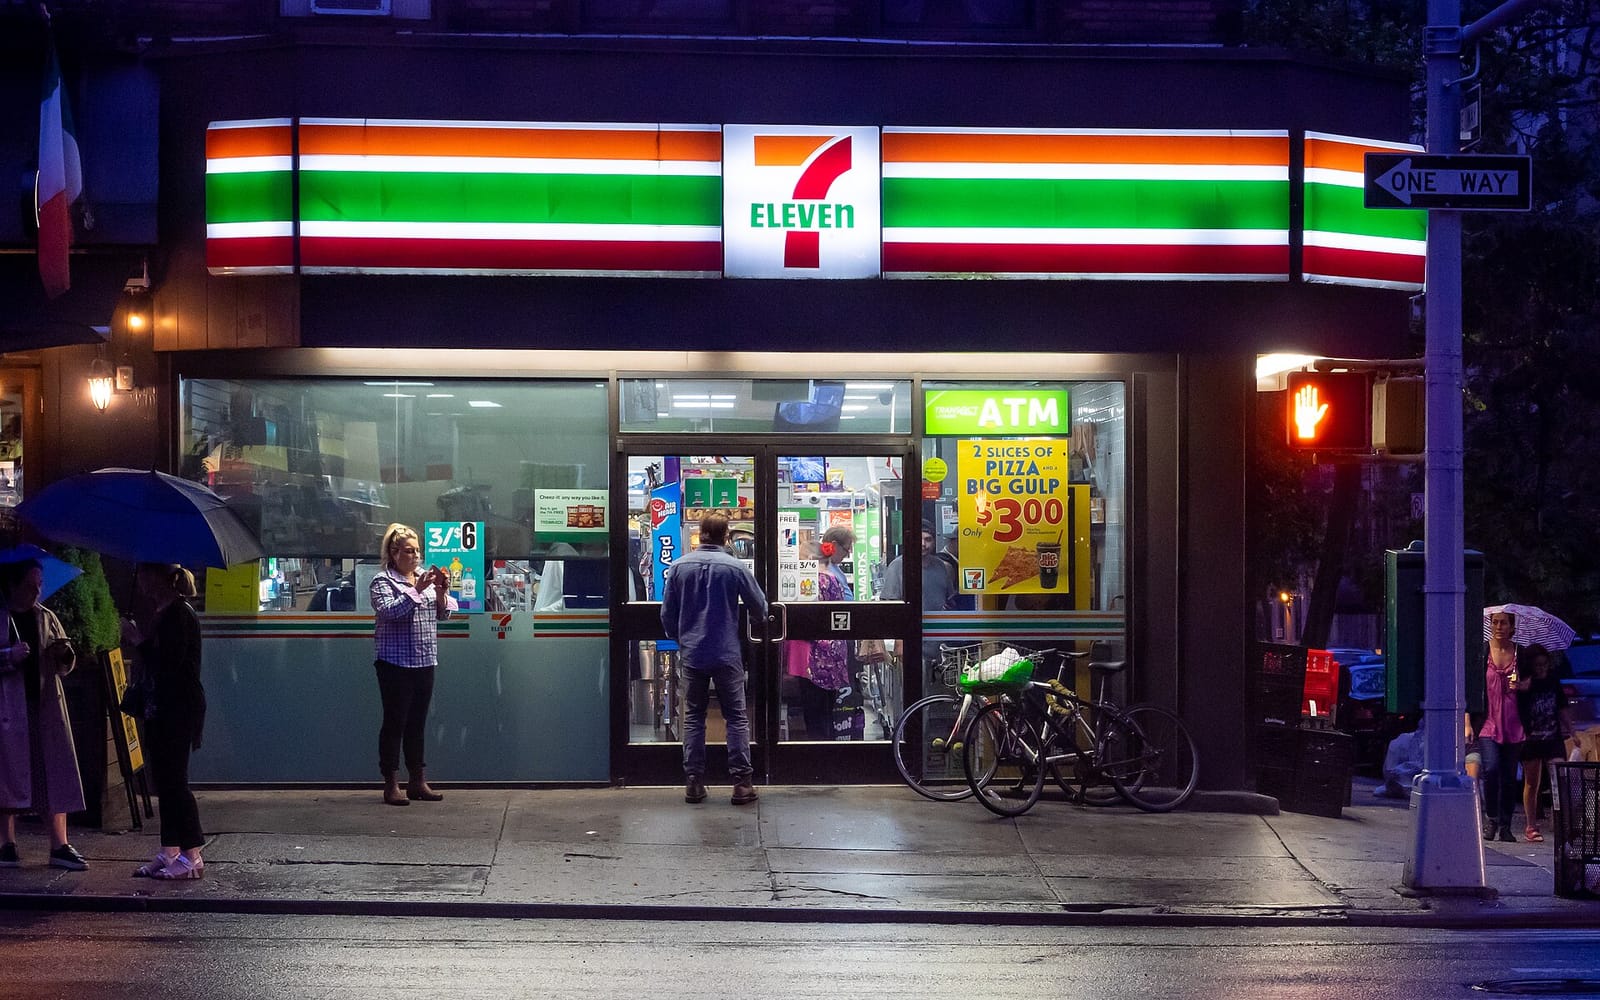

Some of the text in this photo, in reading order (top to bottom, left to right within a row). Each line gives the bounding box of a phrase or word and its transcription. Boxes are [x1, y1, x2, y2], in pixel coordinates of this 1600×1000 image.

[1391, 172, 1509, 193] ONE WAY
[754, 135, 852, 268] 7
[978, 397, 1059, 427] ATM
[973, 445, 1053, 458] 2 SLICES OF
[986, 460, 1040, 476] PIZZA
[967, 479, 1060, 495] BIG GULP
[962, 528, 982, 538] Only
[660, 536, 674, 566] play
[967, 571, 982, 589] 7
[491, 613, 512, 640] 7
